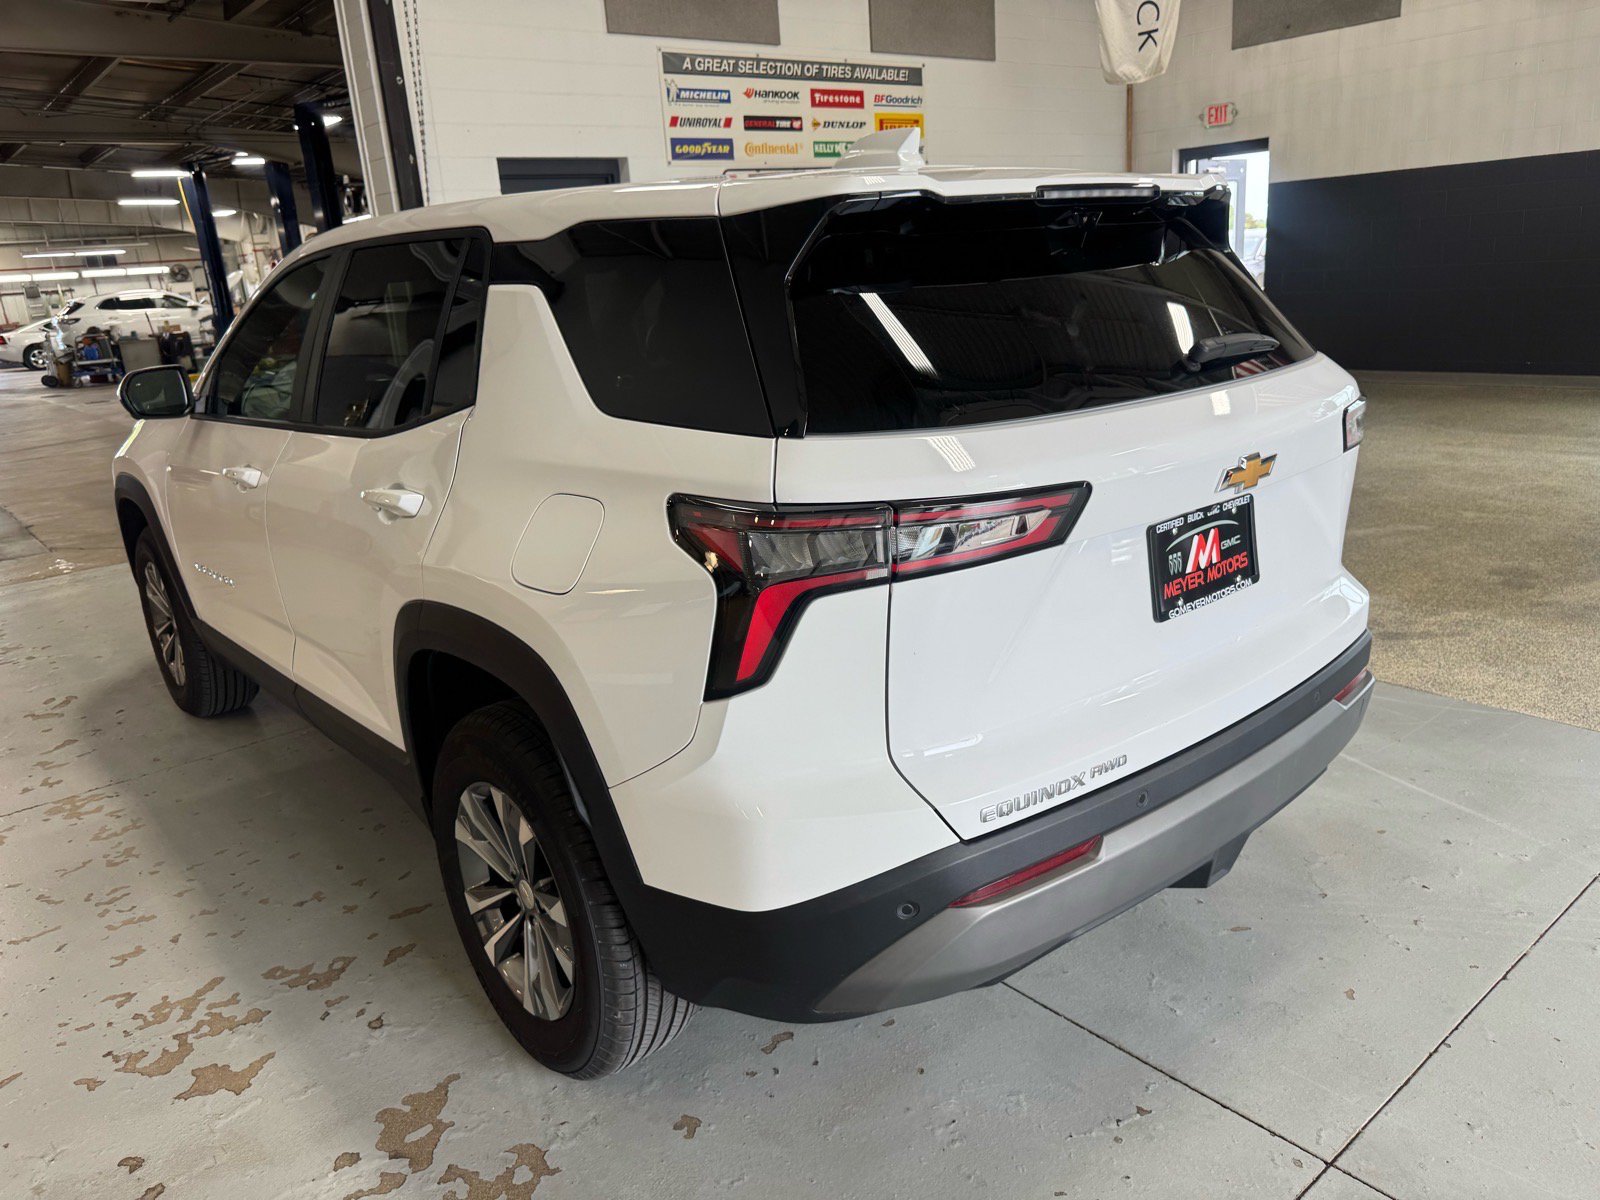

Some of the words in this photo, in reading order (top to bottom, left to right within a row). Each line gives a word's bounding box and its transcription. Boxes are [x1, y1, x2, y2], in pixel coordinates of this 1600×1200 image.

[682, 57, 692, 70] A
[695, 58, 735, 73] GREAT
[738, 60, 802, 76] SELECTION
[804, 64, 820, 77] OF
[821, 65, 852, 78] TIRES
[853, 67, 909, 81] AVAILABLE!
[680, 90, 729, 100] MICHELIN
[874, 94, 922, 105] BFGoodrich
[1208, 104, 1228, 125] EXIT
[679, 117, 723, 128] UNIROYAL
[823, 121, 866, 129] DUNLOP
[744, 142, 799, 157] Continental
[1156, 517, 1185, 534] CERTIFIED
[1187, 511, 1205, 523] BUICK
[1222, 495, 1251, 511] CHEVROLET
[1220, 535, 1241, 550] GMC
[1164, 571, 1205, 600] MEYER
[1207, 552, 1249, 583] MOTORS
[979, 771, 1086, 823] EQUINOX
[1090, 754, 1128, 779] AWD
